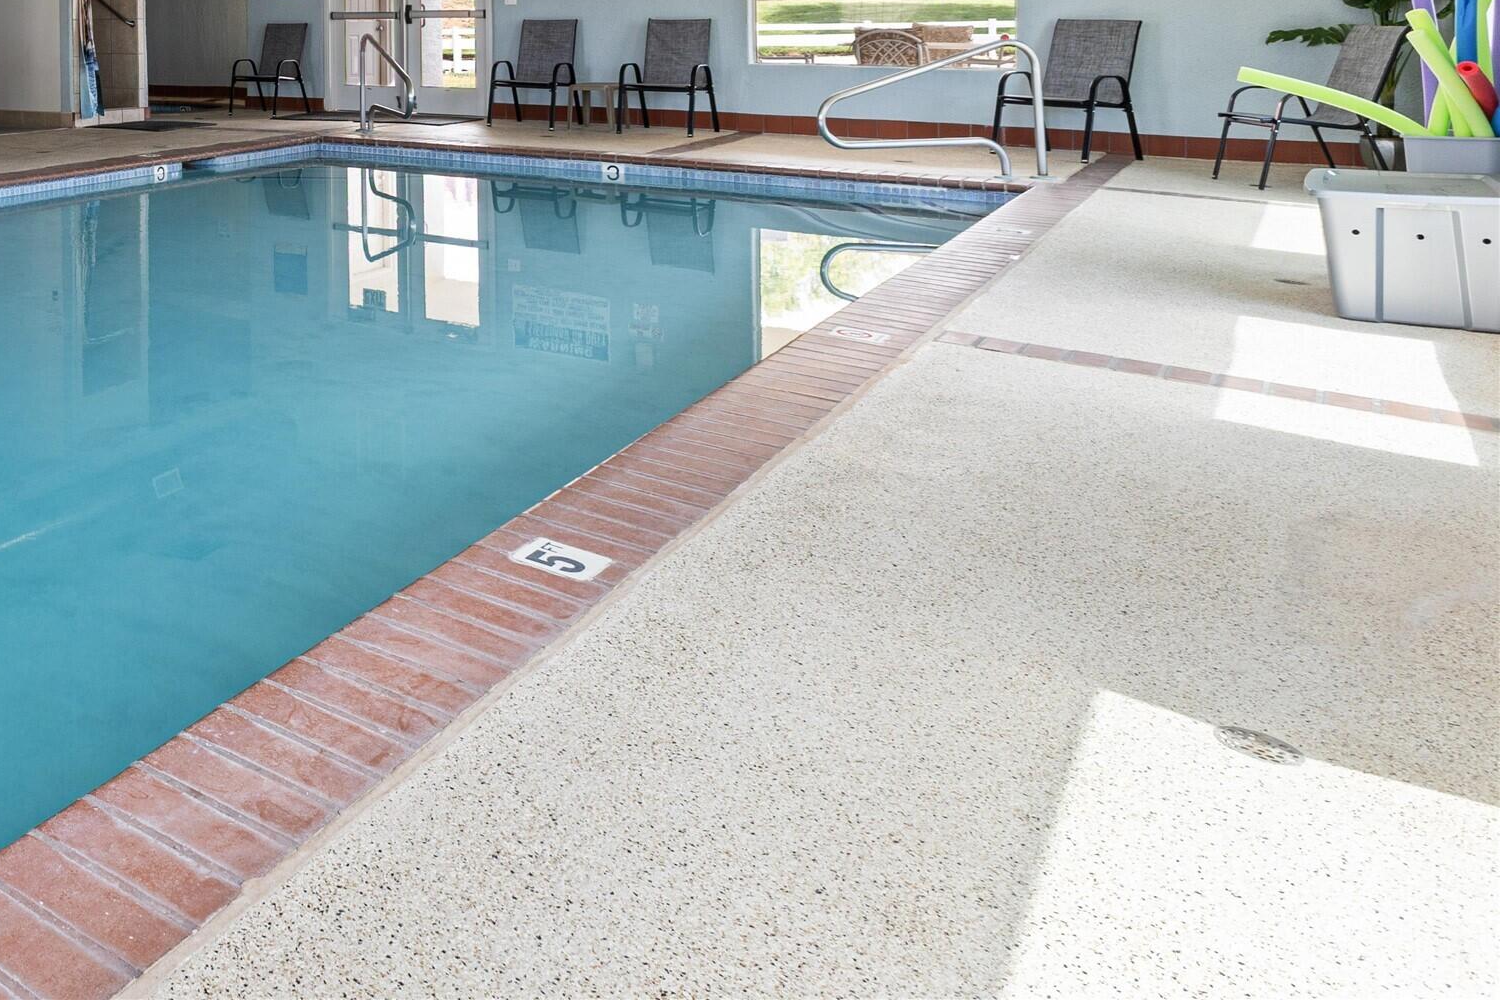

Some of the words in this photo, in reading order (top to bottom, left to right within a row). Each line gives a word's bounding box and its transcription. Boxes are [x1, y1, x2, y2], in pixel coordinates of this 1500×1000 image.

[157, 166, 165, 181] 3
[607, 165, 619, 181] 3
[525, 549, 586, 573] 5
